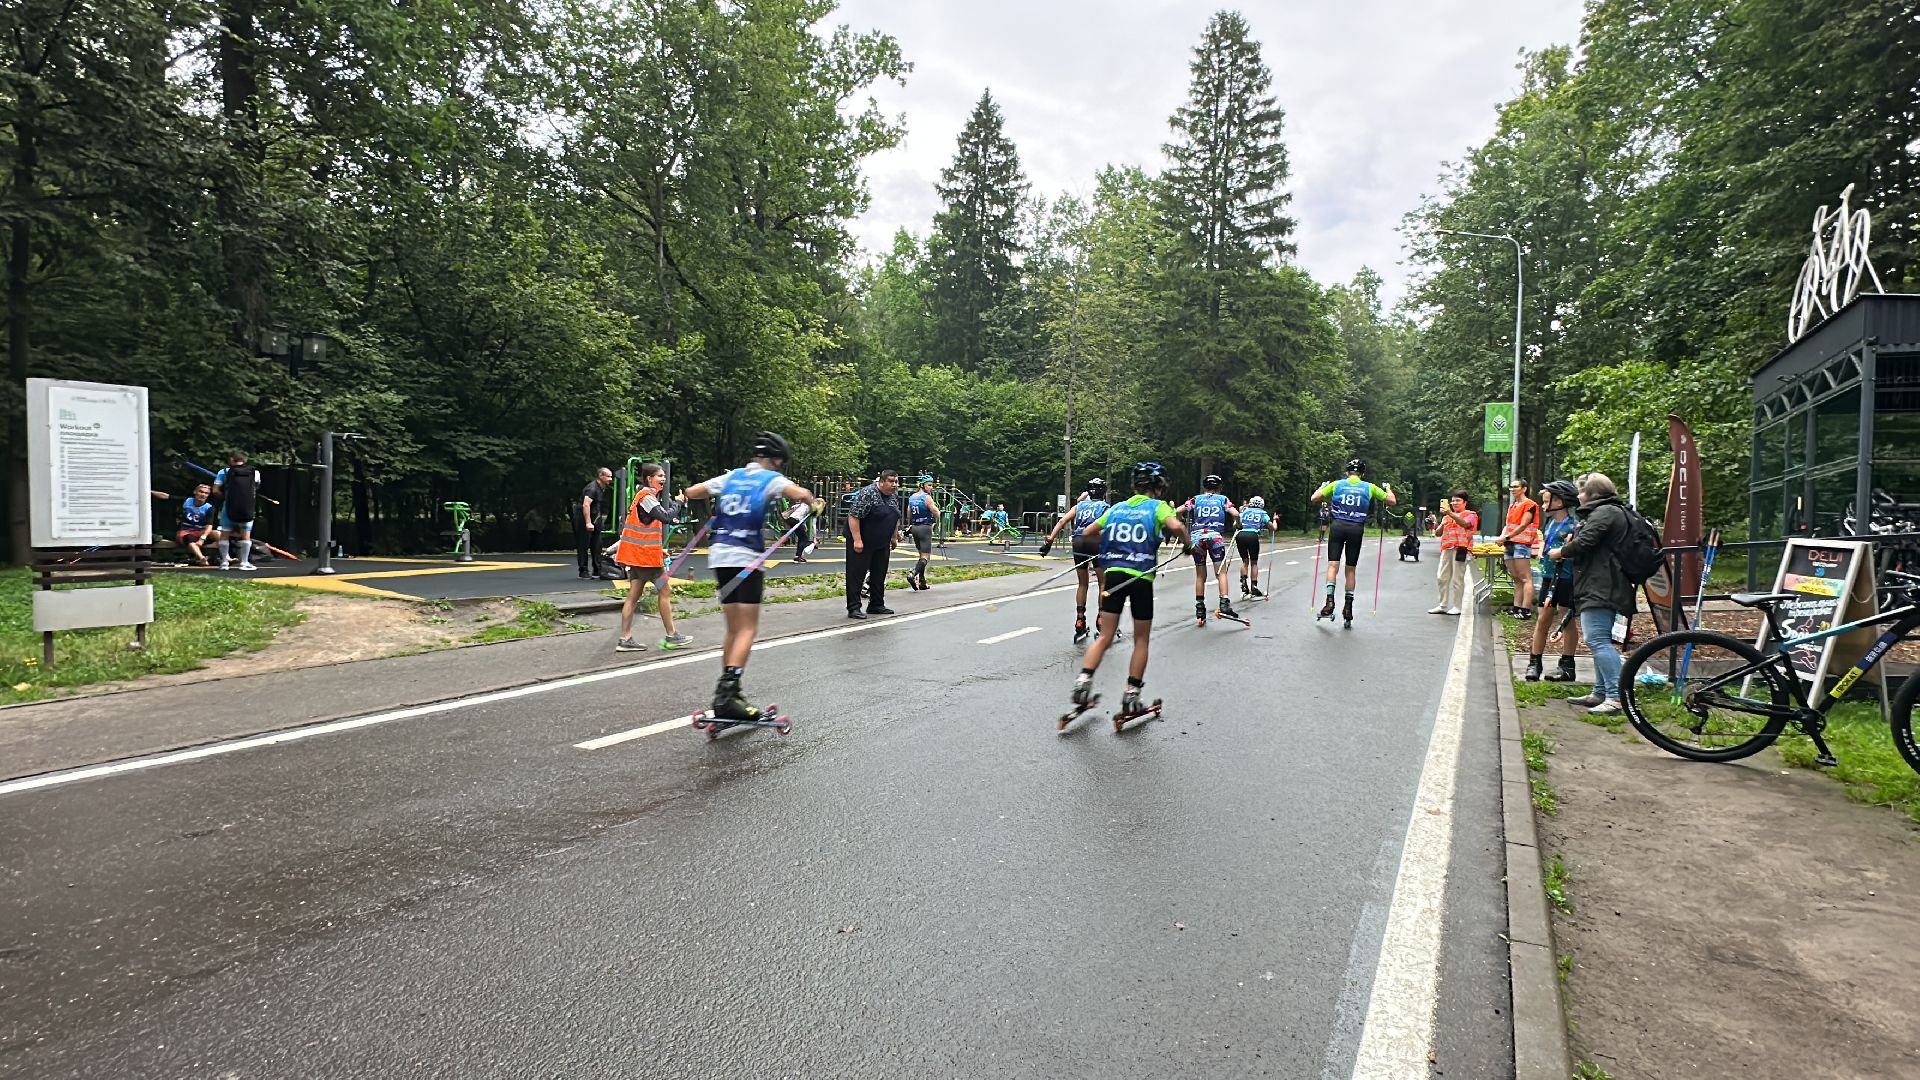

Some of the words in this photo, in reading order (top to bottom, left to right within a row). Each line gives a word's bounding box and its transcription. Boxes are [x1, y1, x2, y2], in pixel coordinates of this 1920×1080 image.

[1340, 493, 1361, 507] 181
[1196, 506, 1220, 518] 192
[1106, 522, 1148, 544] 180
[1835, 671, 1858, 693] ПРОКАТ
